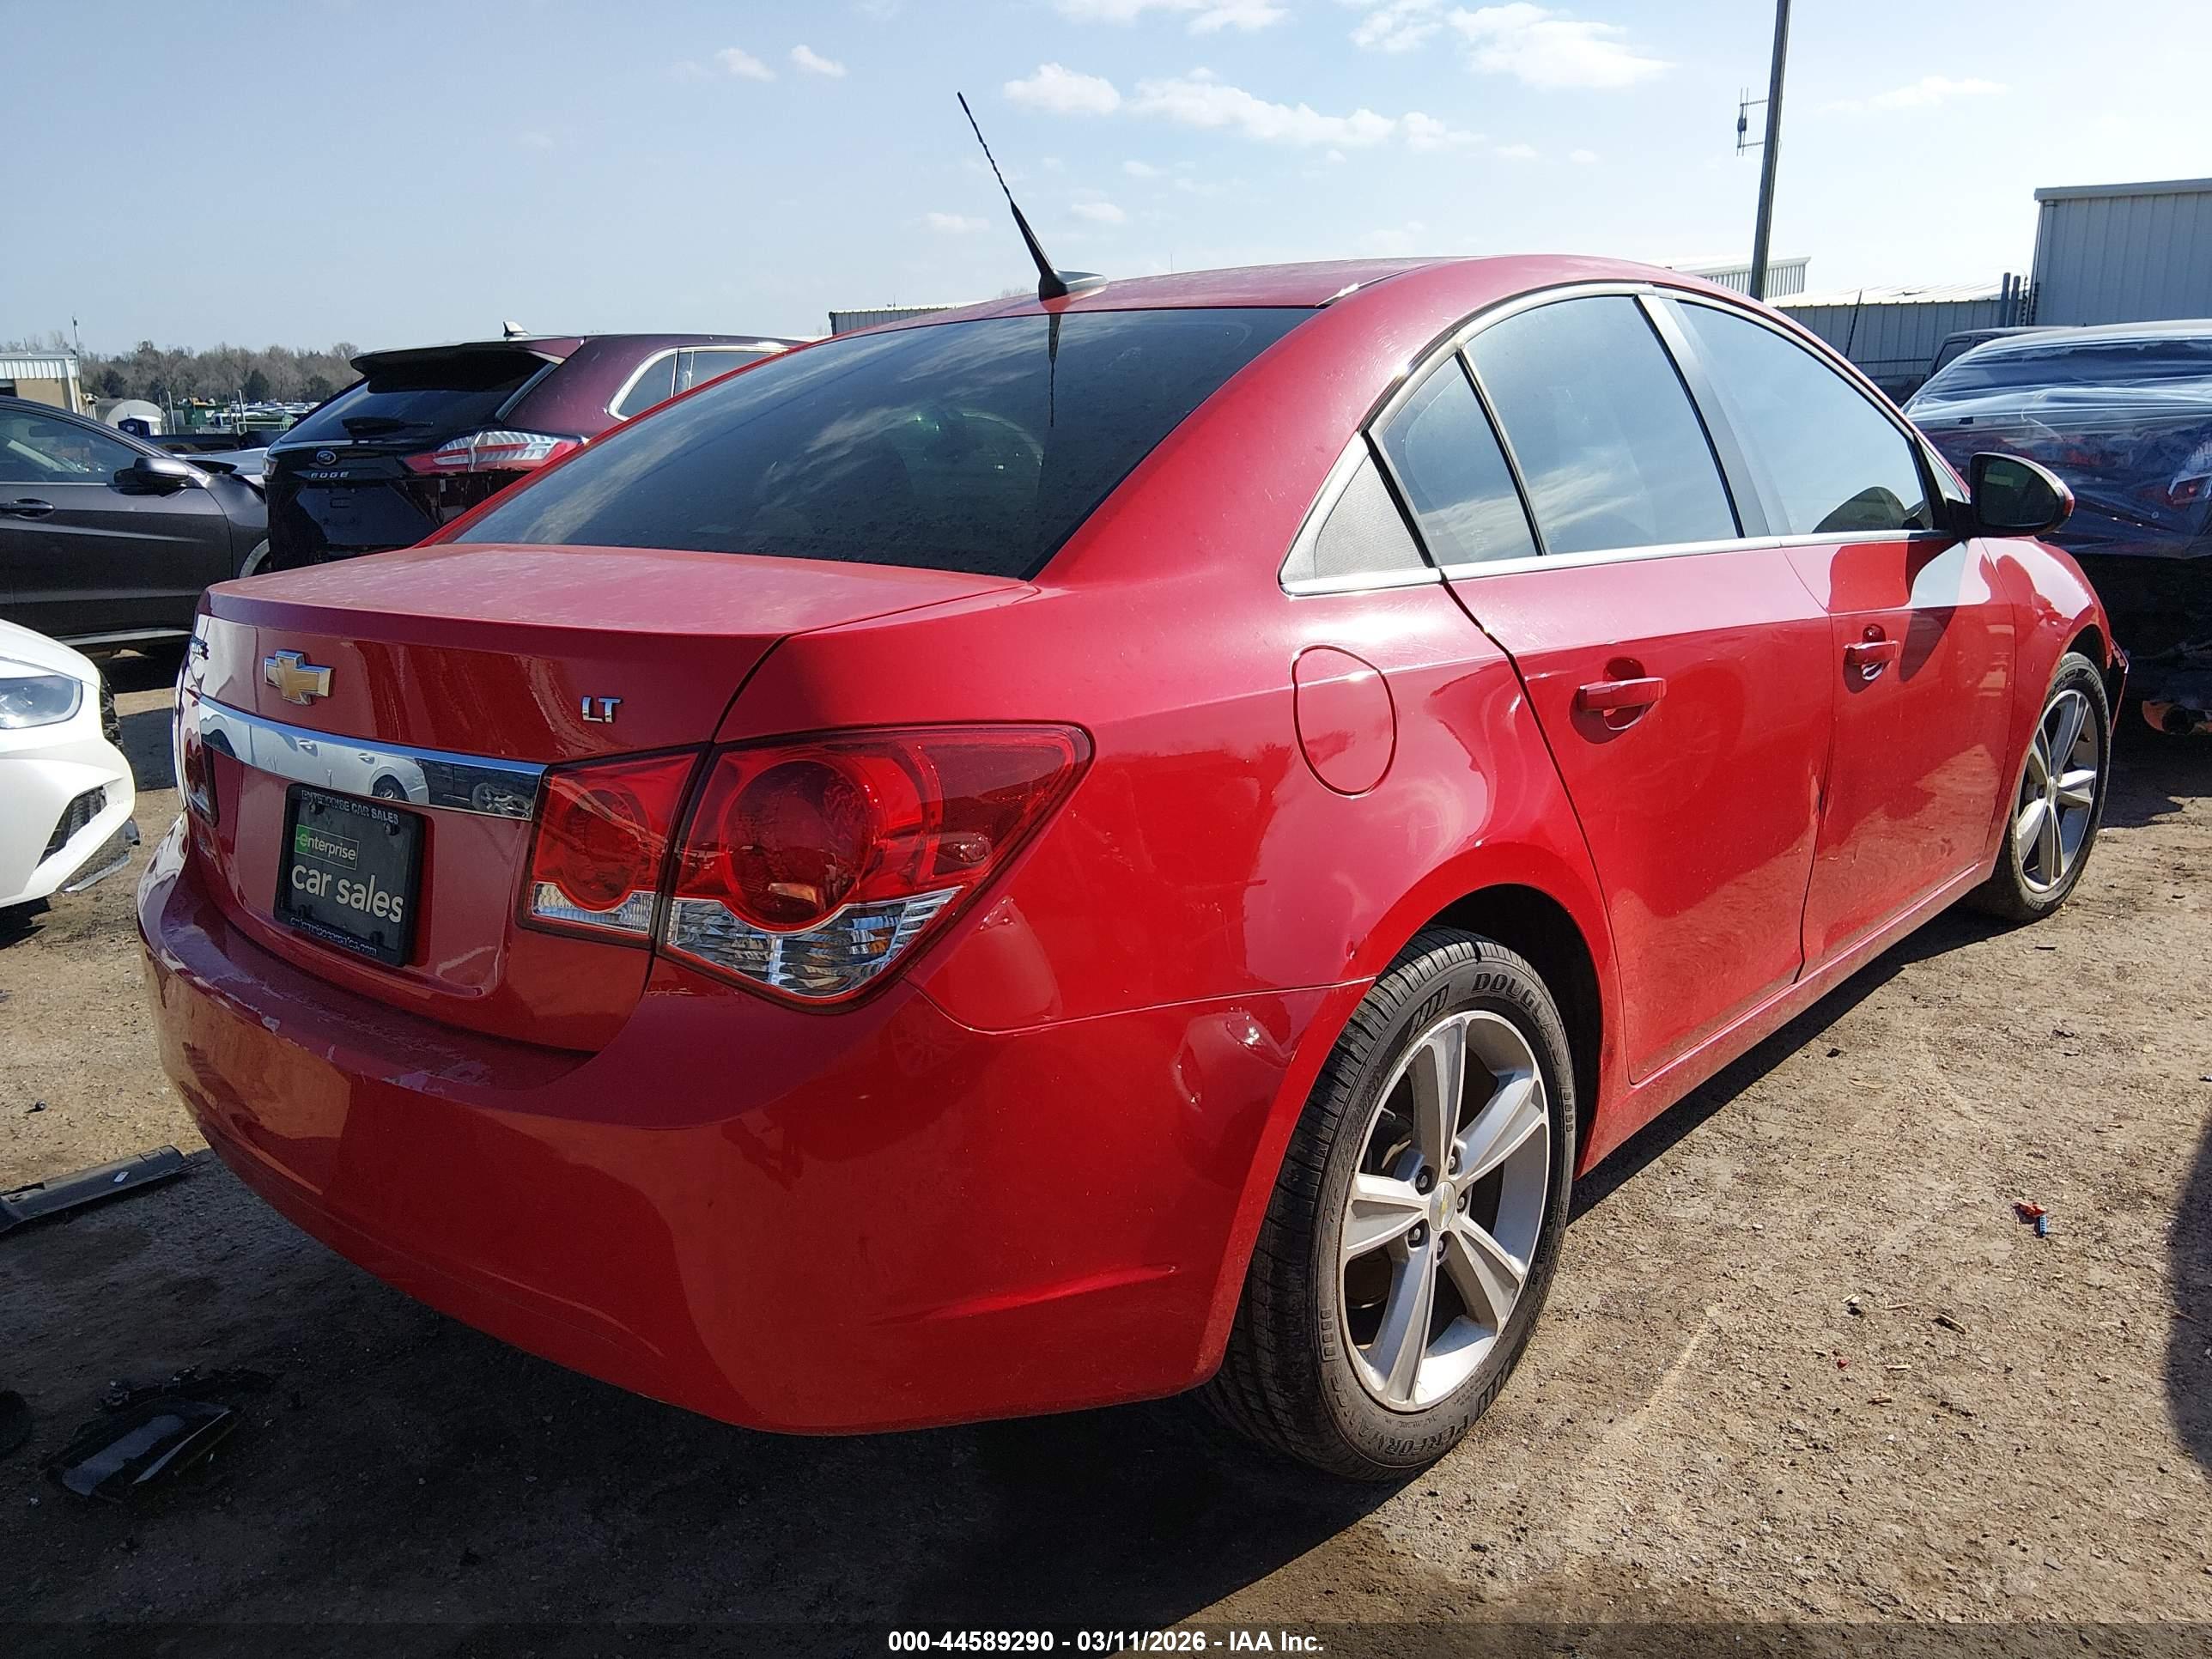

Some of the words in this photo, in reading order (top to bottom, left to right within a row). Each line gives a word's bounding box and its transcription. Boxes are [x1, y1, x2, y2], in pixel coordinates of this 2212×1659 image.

[582, 696, 621, 723] LT
[351, 803, 369, 817] CAR
[371, 808, 398, 825] SALES
[298, 832, 356, 861] enterprise
[291, 865, 332, 898] car
[336, 874, 404, 923] sales
